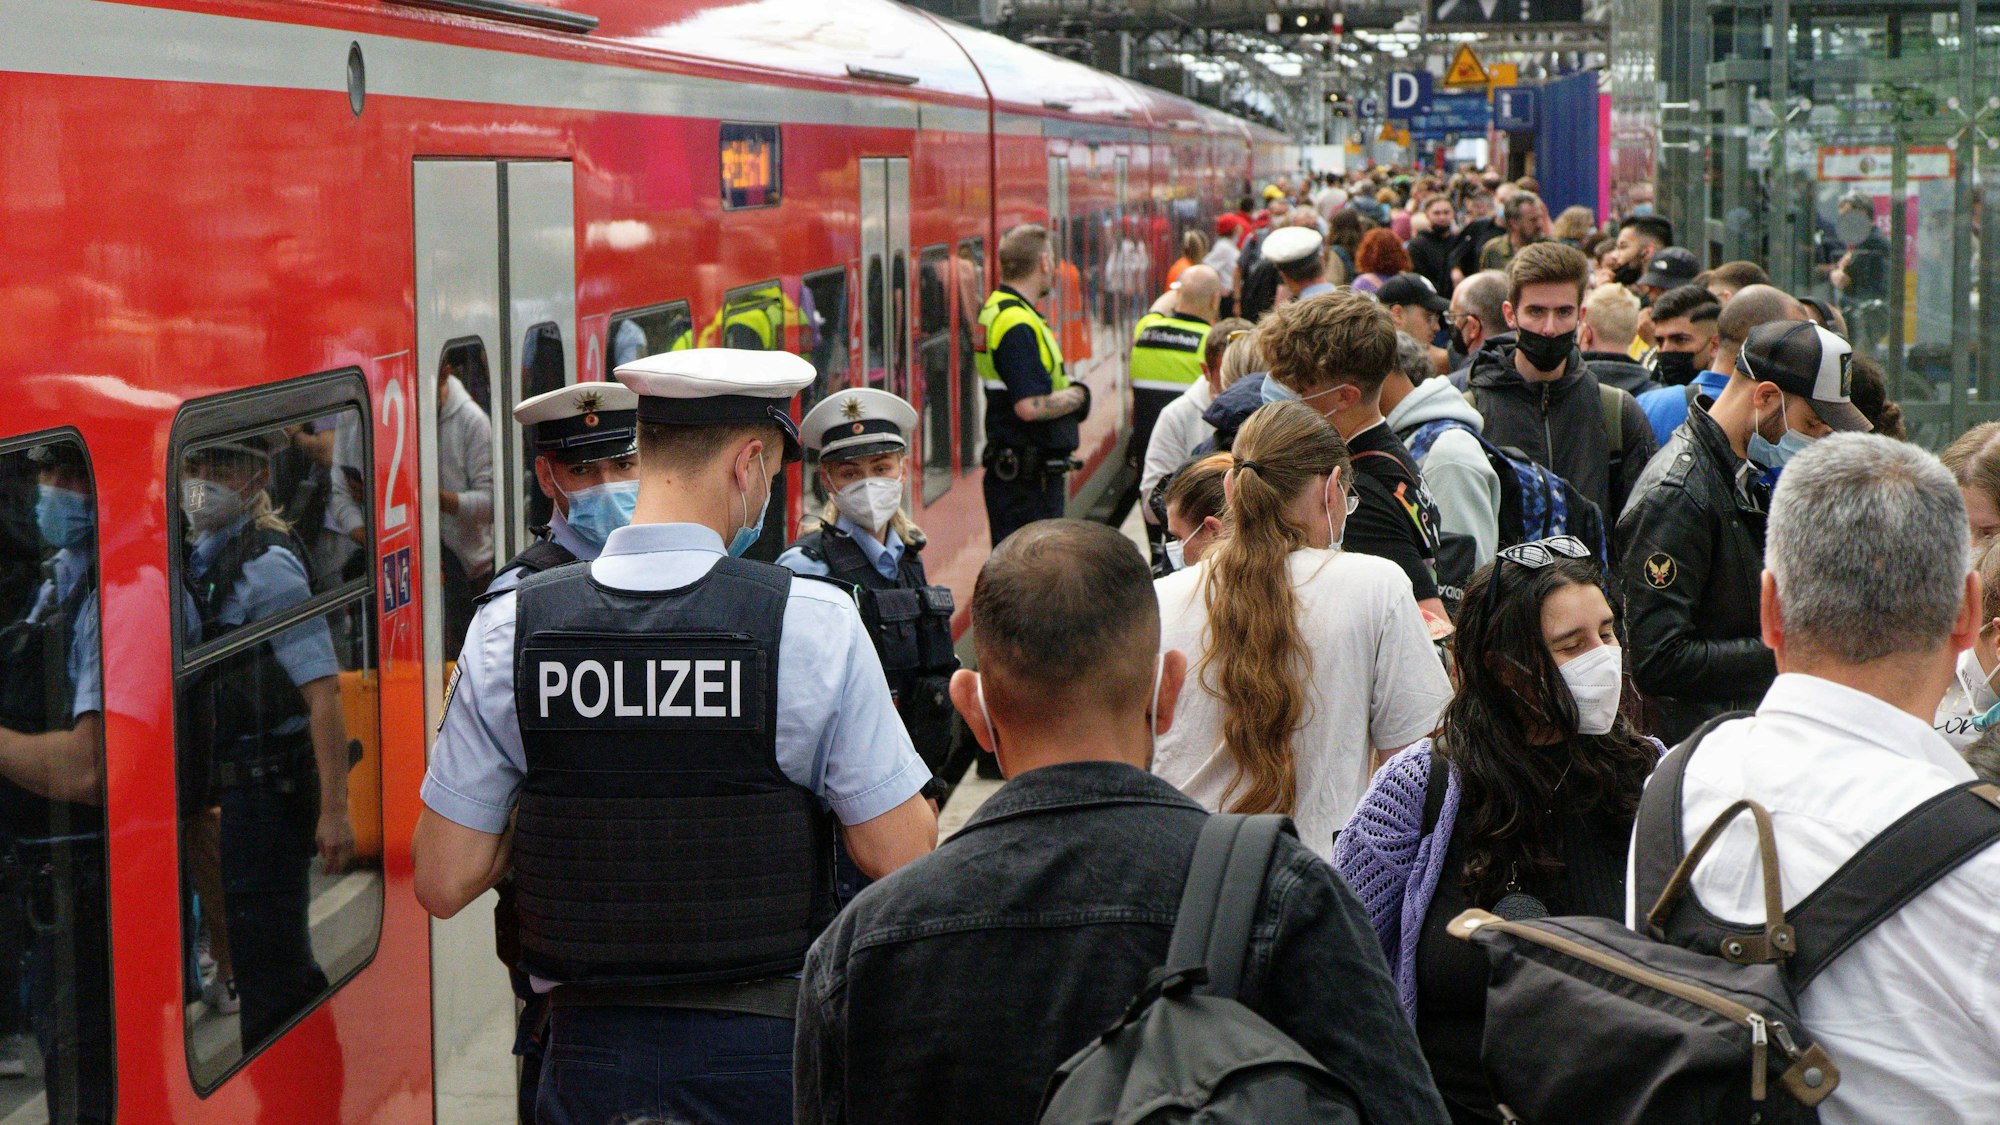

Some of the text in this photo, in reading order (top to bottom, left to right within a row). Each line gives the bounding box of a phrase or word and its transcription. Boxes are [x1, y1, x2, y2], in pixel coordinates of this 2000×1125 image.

[1360, 99, 1377, 117] C
[1391, 72, 1419, 109] D
[381, 378, 407, 531] 2
[539, 659, 741, 718] POLIZEI
